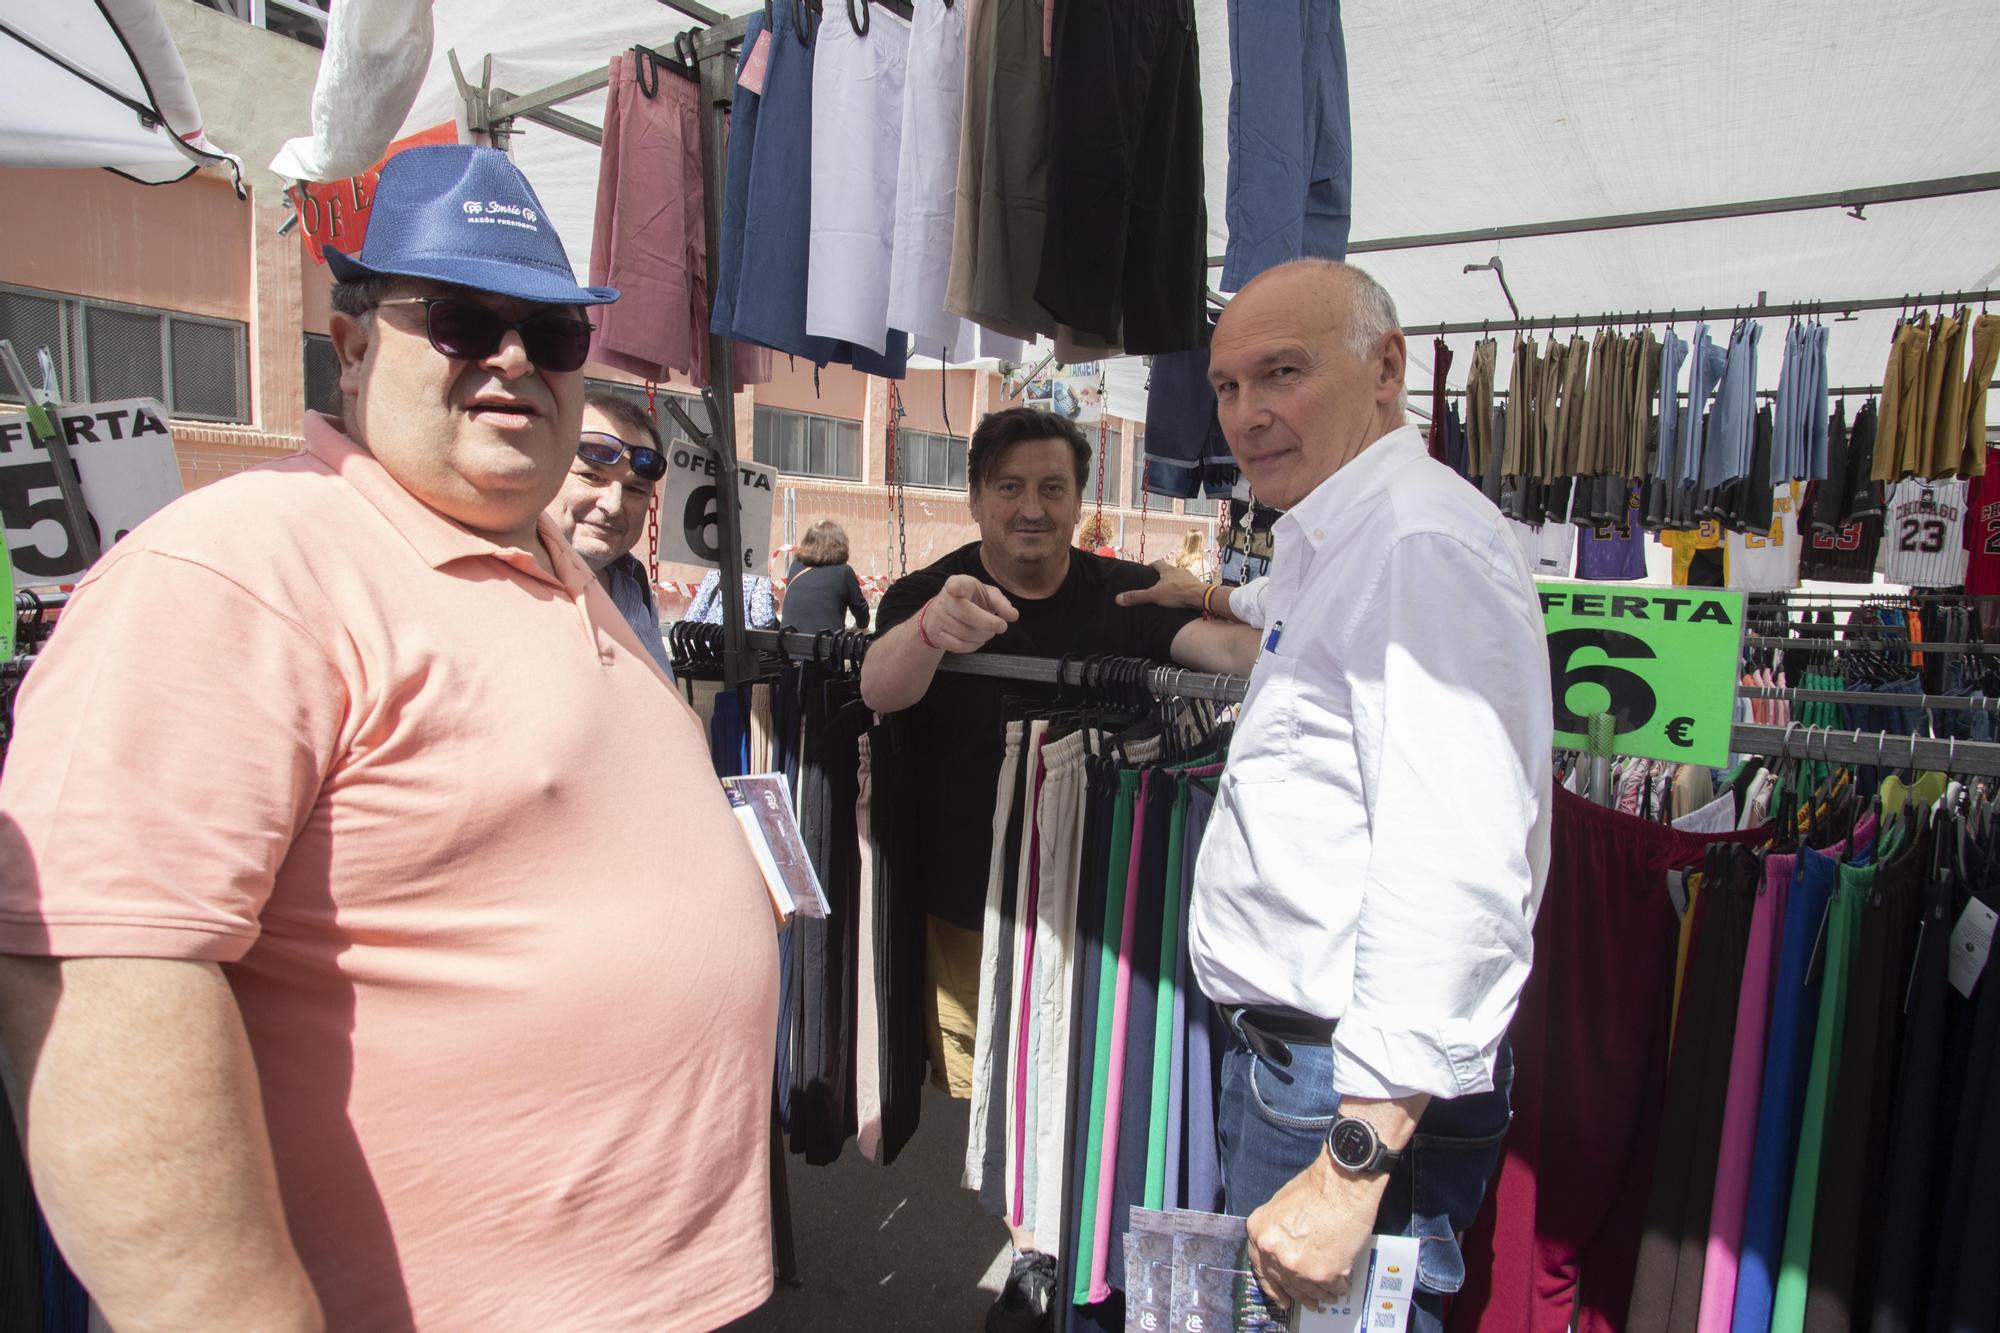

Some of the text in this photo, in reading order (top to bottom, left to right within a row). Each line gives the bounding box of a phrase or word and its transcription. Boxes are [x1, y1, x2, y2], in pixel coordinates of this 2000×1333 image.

[302, 173, 380, 239] OFE
[497, 218, 537, 232] PRESIDENTE
[674, 450, 771, 491] OFETA
[0, 459, 102, 577] 5
[684, 485, 753, 567] 6 €
[1901, 519, 1947, 553] 23
[1546, 628, 1695, 747] 6 €
